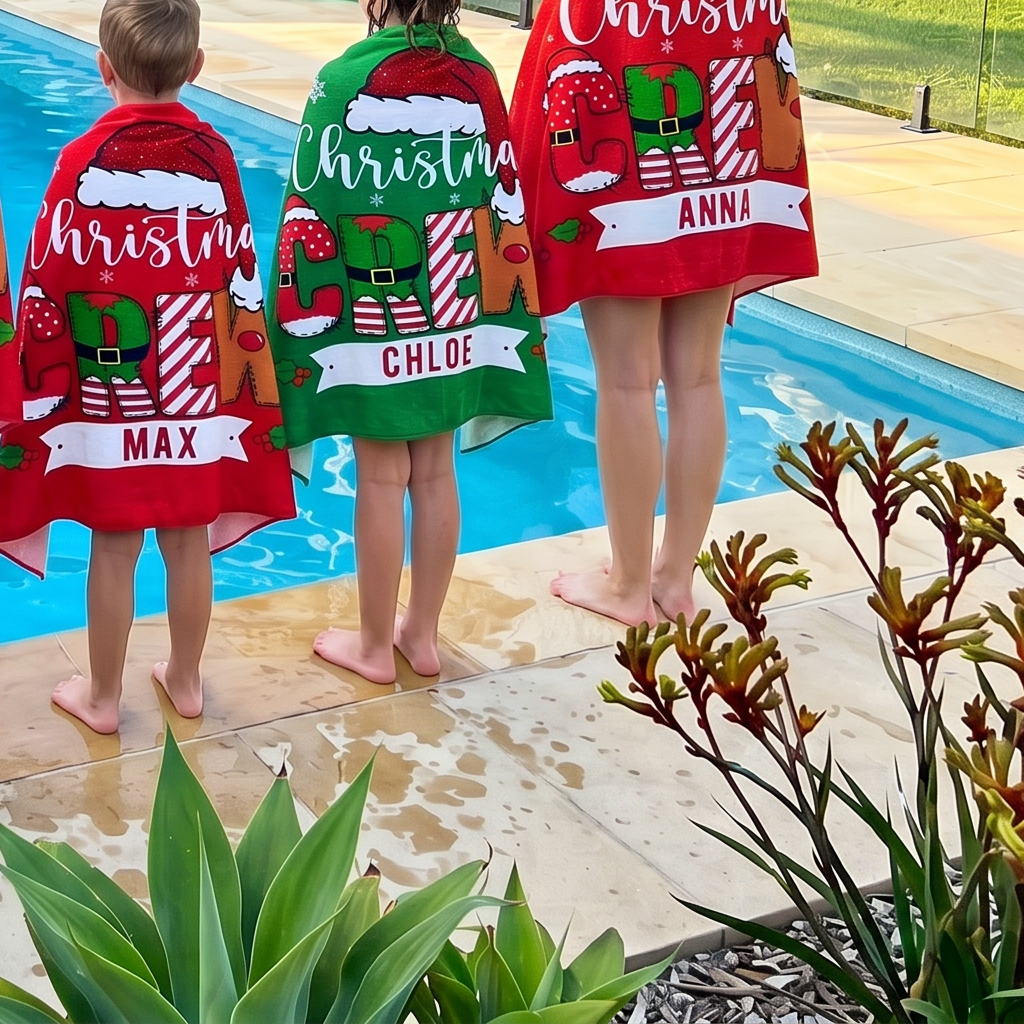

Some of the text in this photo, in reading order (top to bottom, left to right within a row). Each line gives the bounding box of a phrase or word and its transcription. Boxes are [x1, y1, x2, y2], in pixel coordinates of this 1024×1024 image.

[292, 123, 518, 192] Christma
[678, 187, 751, 230] ANNA
[31, 198, 256, 270] Christma
[381, 333, 473, 378] CHLOE
[122, 426, 198, 462] MAX
